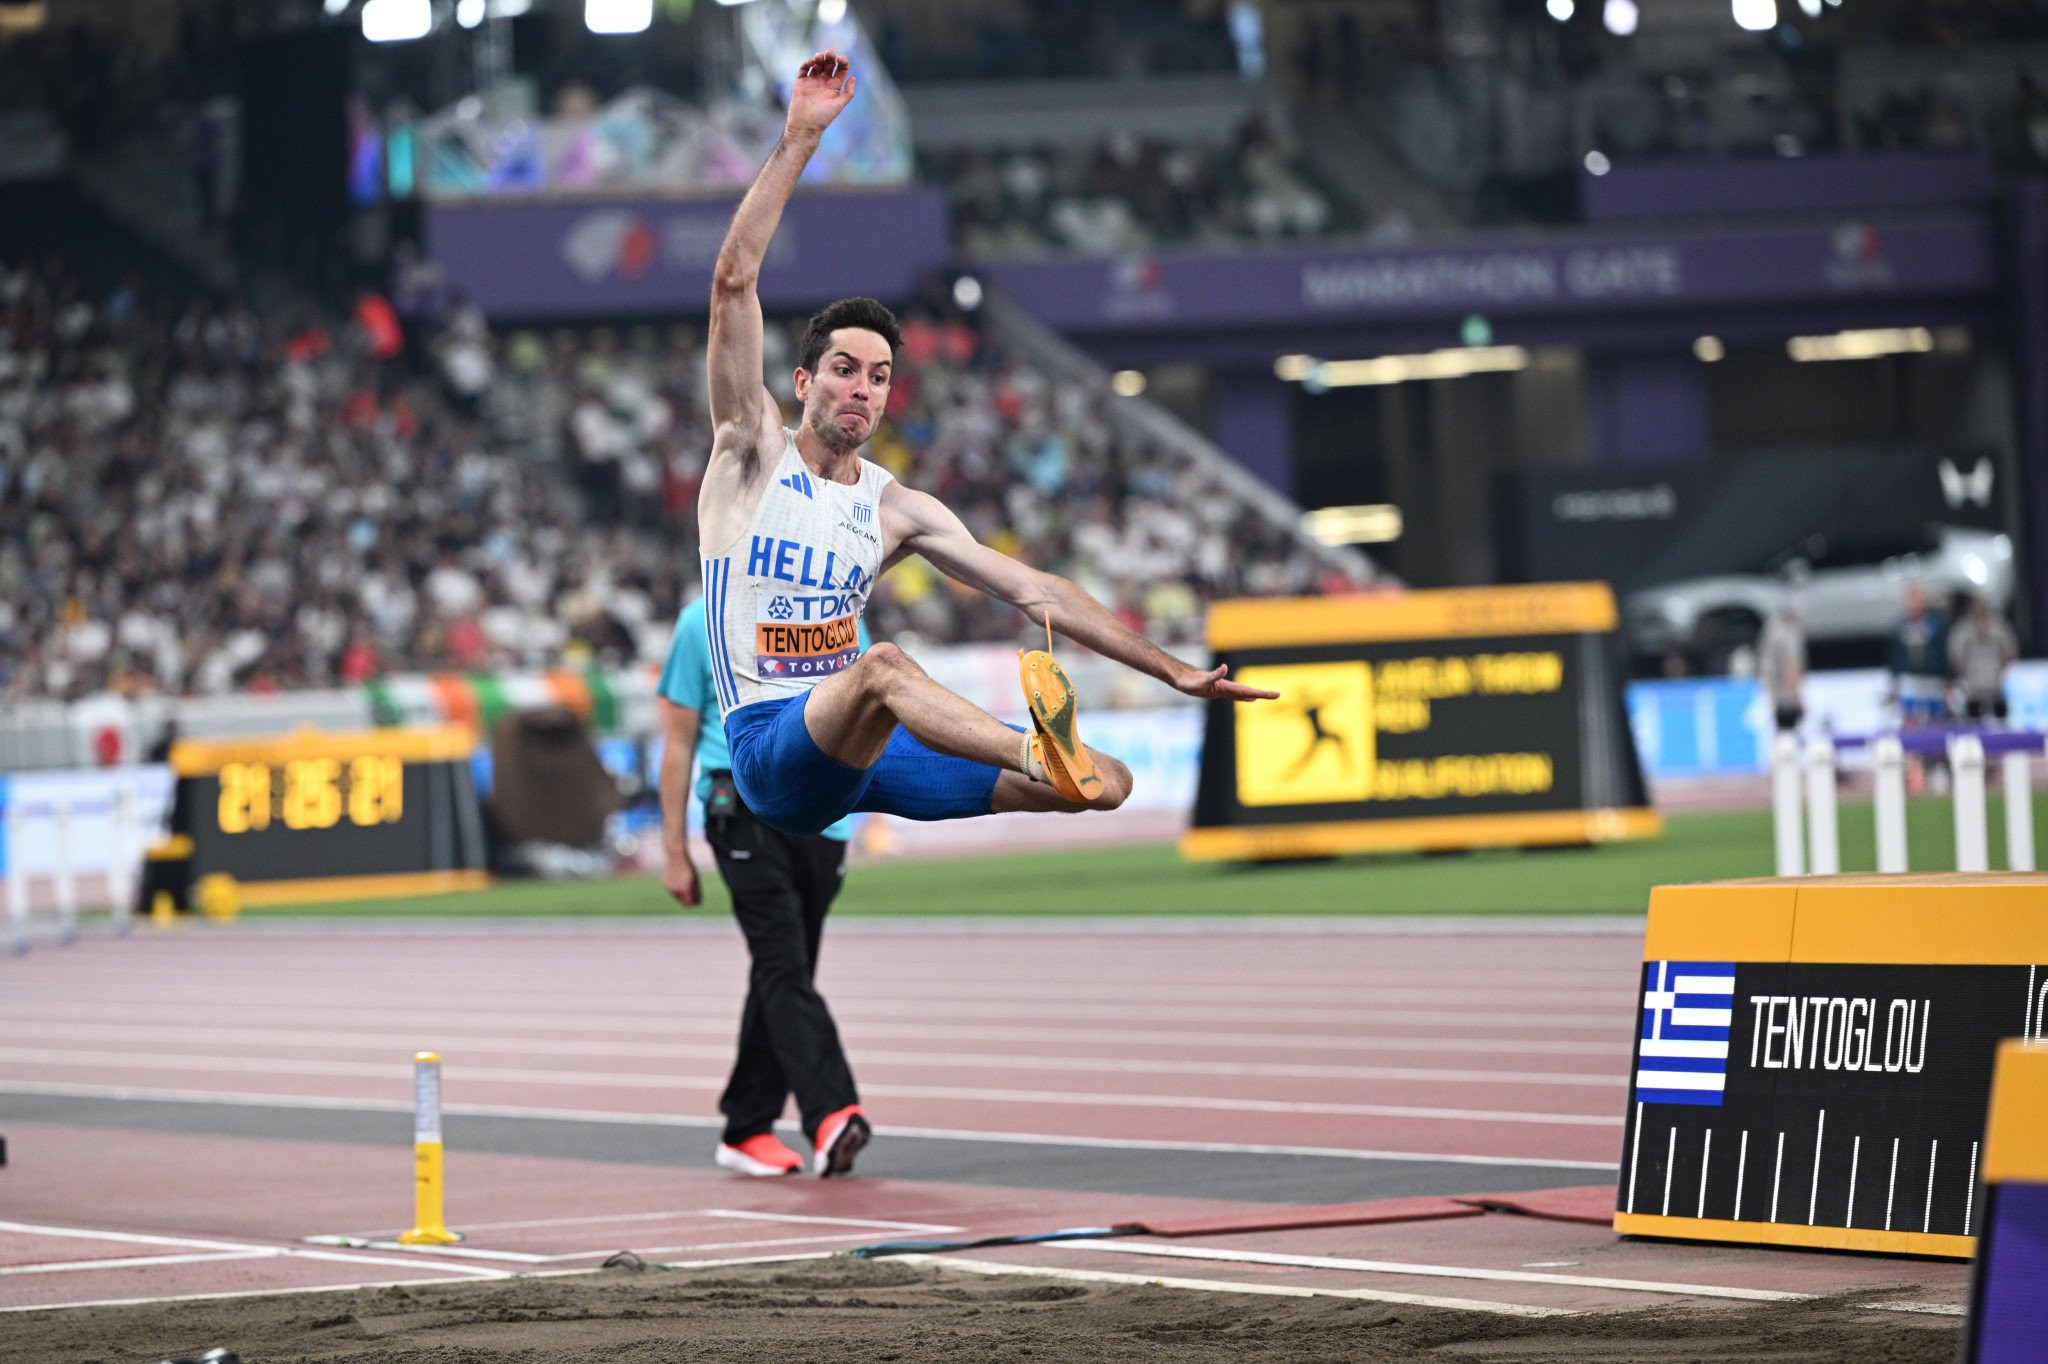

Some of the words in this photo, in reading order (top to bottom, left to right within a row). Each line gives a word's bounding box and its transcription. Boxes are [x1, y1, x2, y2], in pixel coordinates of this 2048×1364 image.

[1304, 252, 1556, 307] MARATHON
[1564, 245, 1680, 299] GATE
[838, 521, 877, 544] AEGEAN
[793, 594, 860, 620] TDK
[762, 618, 855, 653] TENTOGLOU
[1750, 995, 1931, 1073] TENTOGLOU
